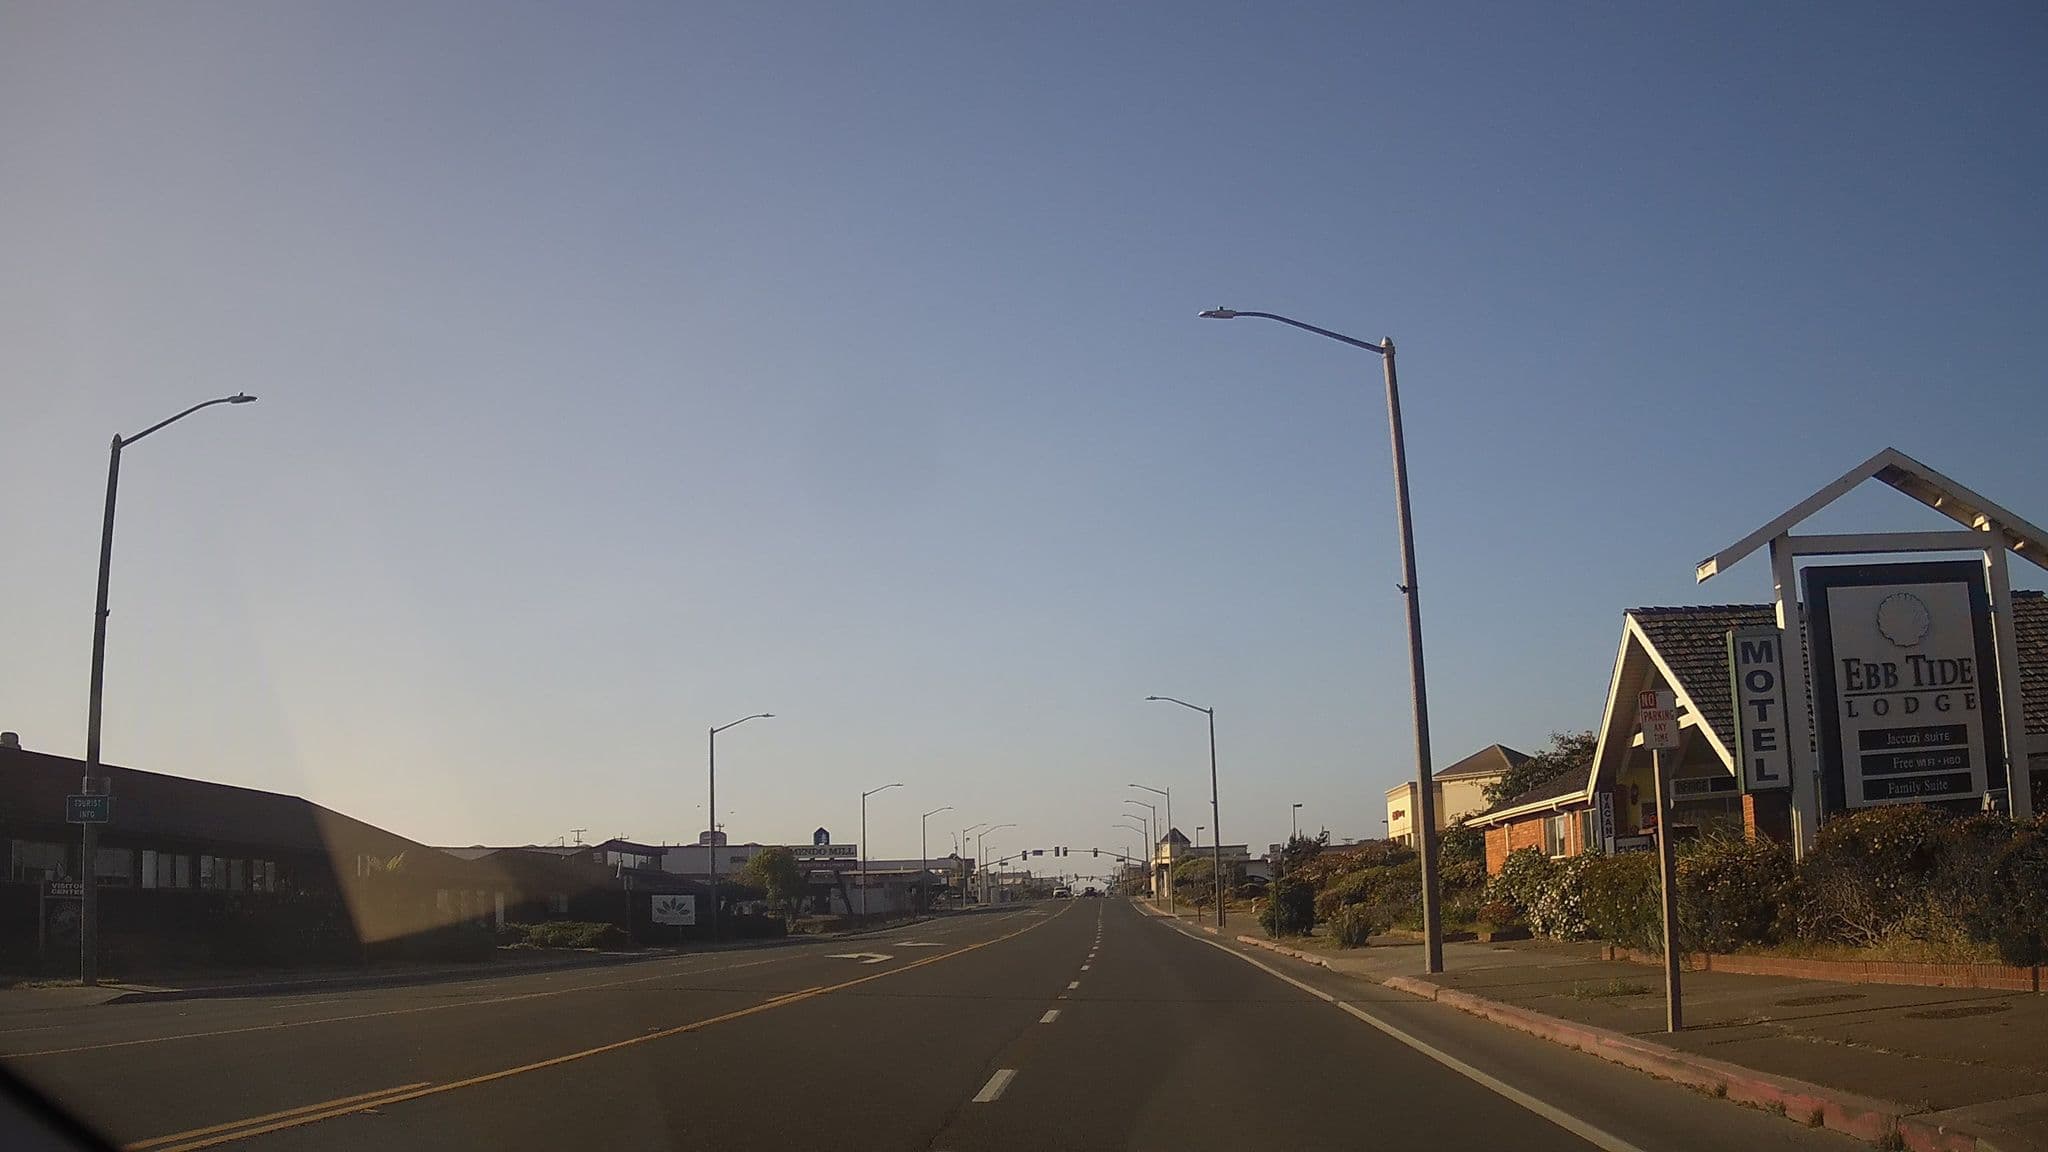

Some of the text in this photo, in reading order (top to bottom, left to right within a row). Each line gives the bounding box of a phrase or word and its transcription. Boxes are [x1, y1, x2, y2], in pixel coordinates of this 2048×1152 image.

[1641, 693, 1654, 707] NO
[1846, 694, 1976, 718] LODGE
[1644, 709, 1675, 722] PARKING
[1741, 640, 1779, 782] MOTEL
[1654, 723, 1666, 732] ANY
[1654, 733, 1668, 742] TIME
[1893, 757, 1914, 769] Free
[1888, 778, 1949, 795] Family Suite
[74, 799, 101, 808] TOURIST
[79, 810, 96, 818] INFO
